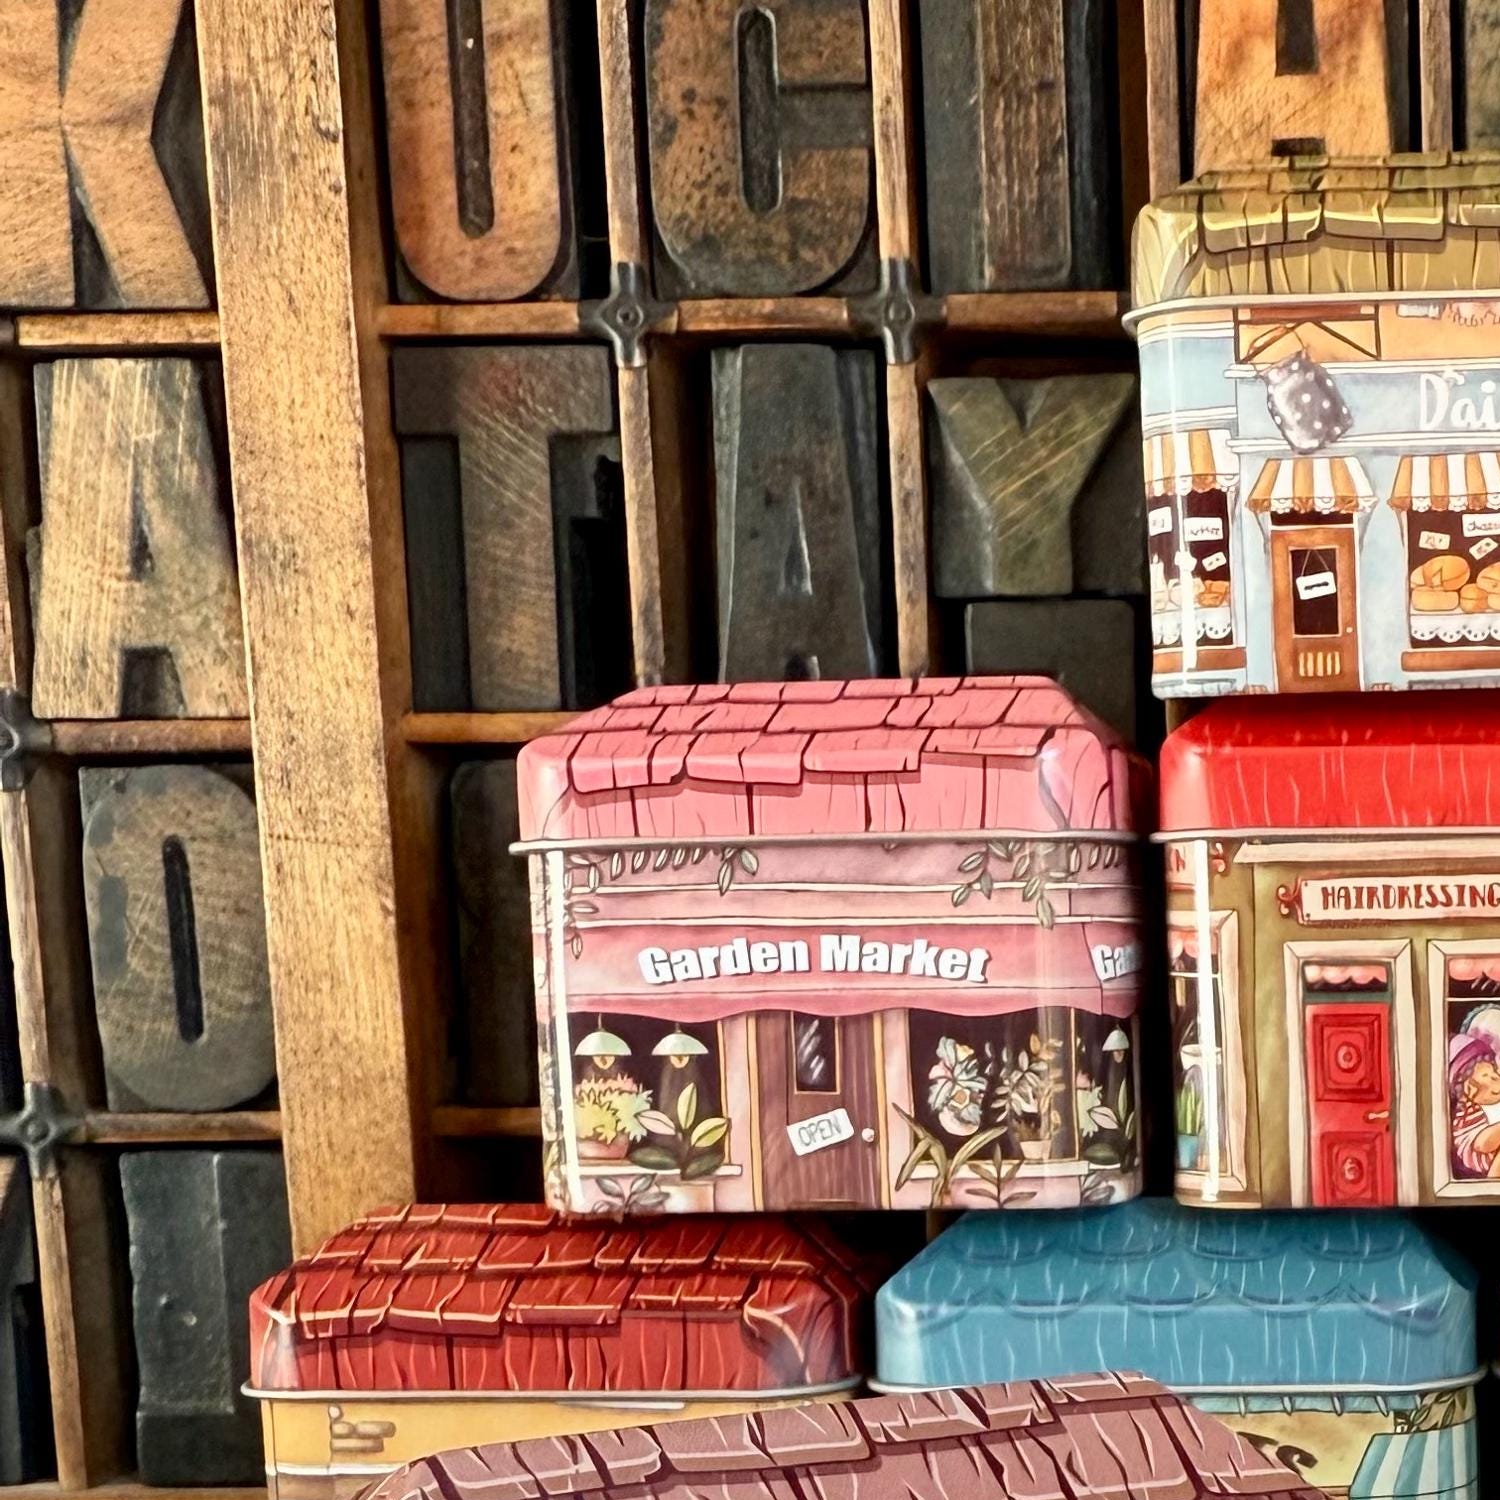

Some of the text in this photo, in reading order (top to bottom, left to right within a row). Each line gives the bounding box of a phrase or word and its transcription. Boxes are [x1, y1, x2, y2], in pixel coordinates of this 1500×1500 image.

[637, 934, 989, 985] Garden Market
[798, 1112, 845, 1147] OPEN
